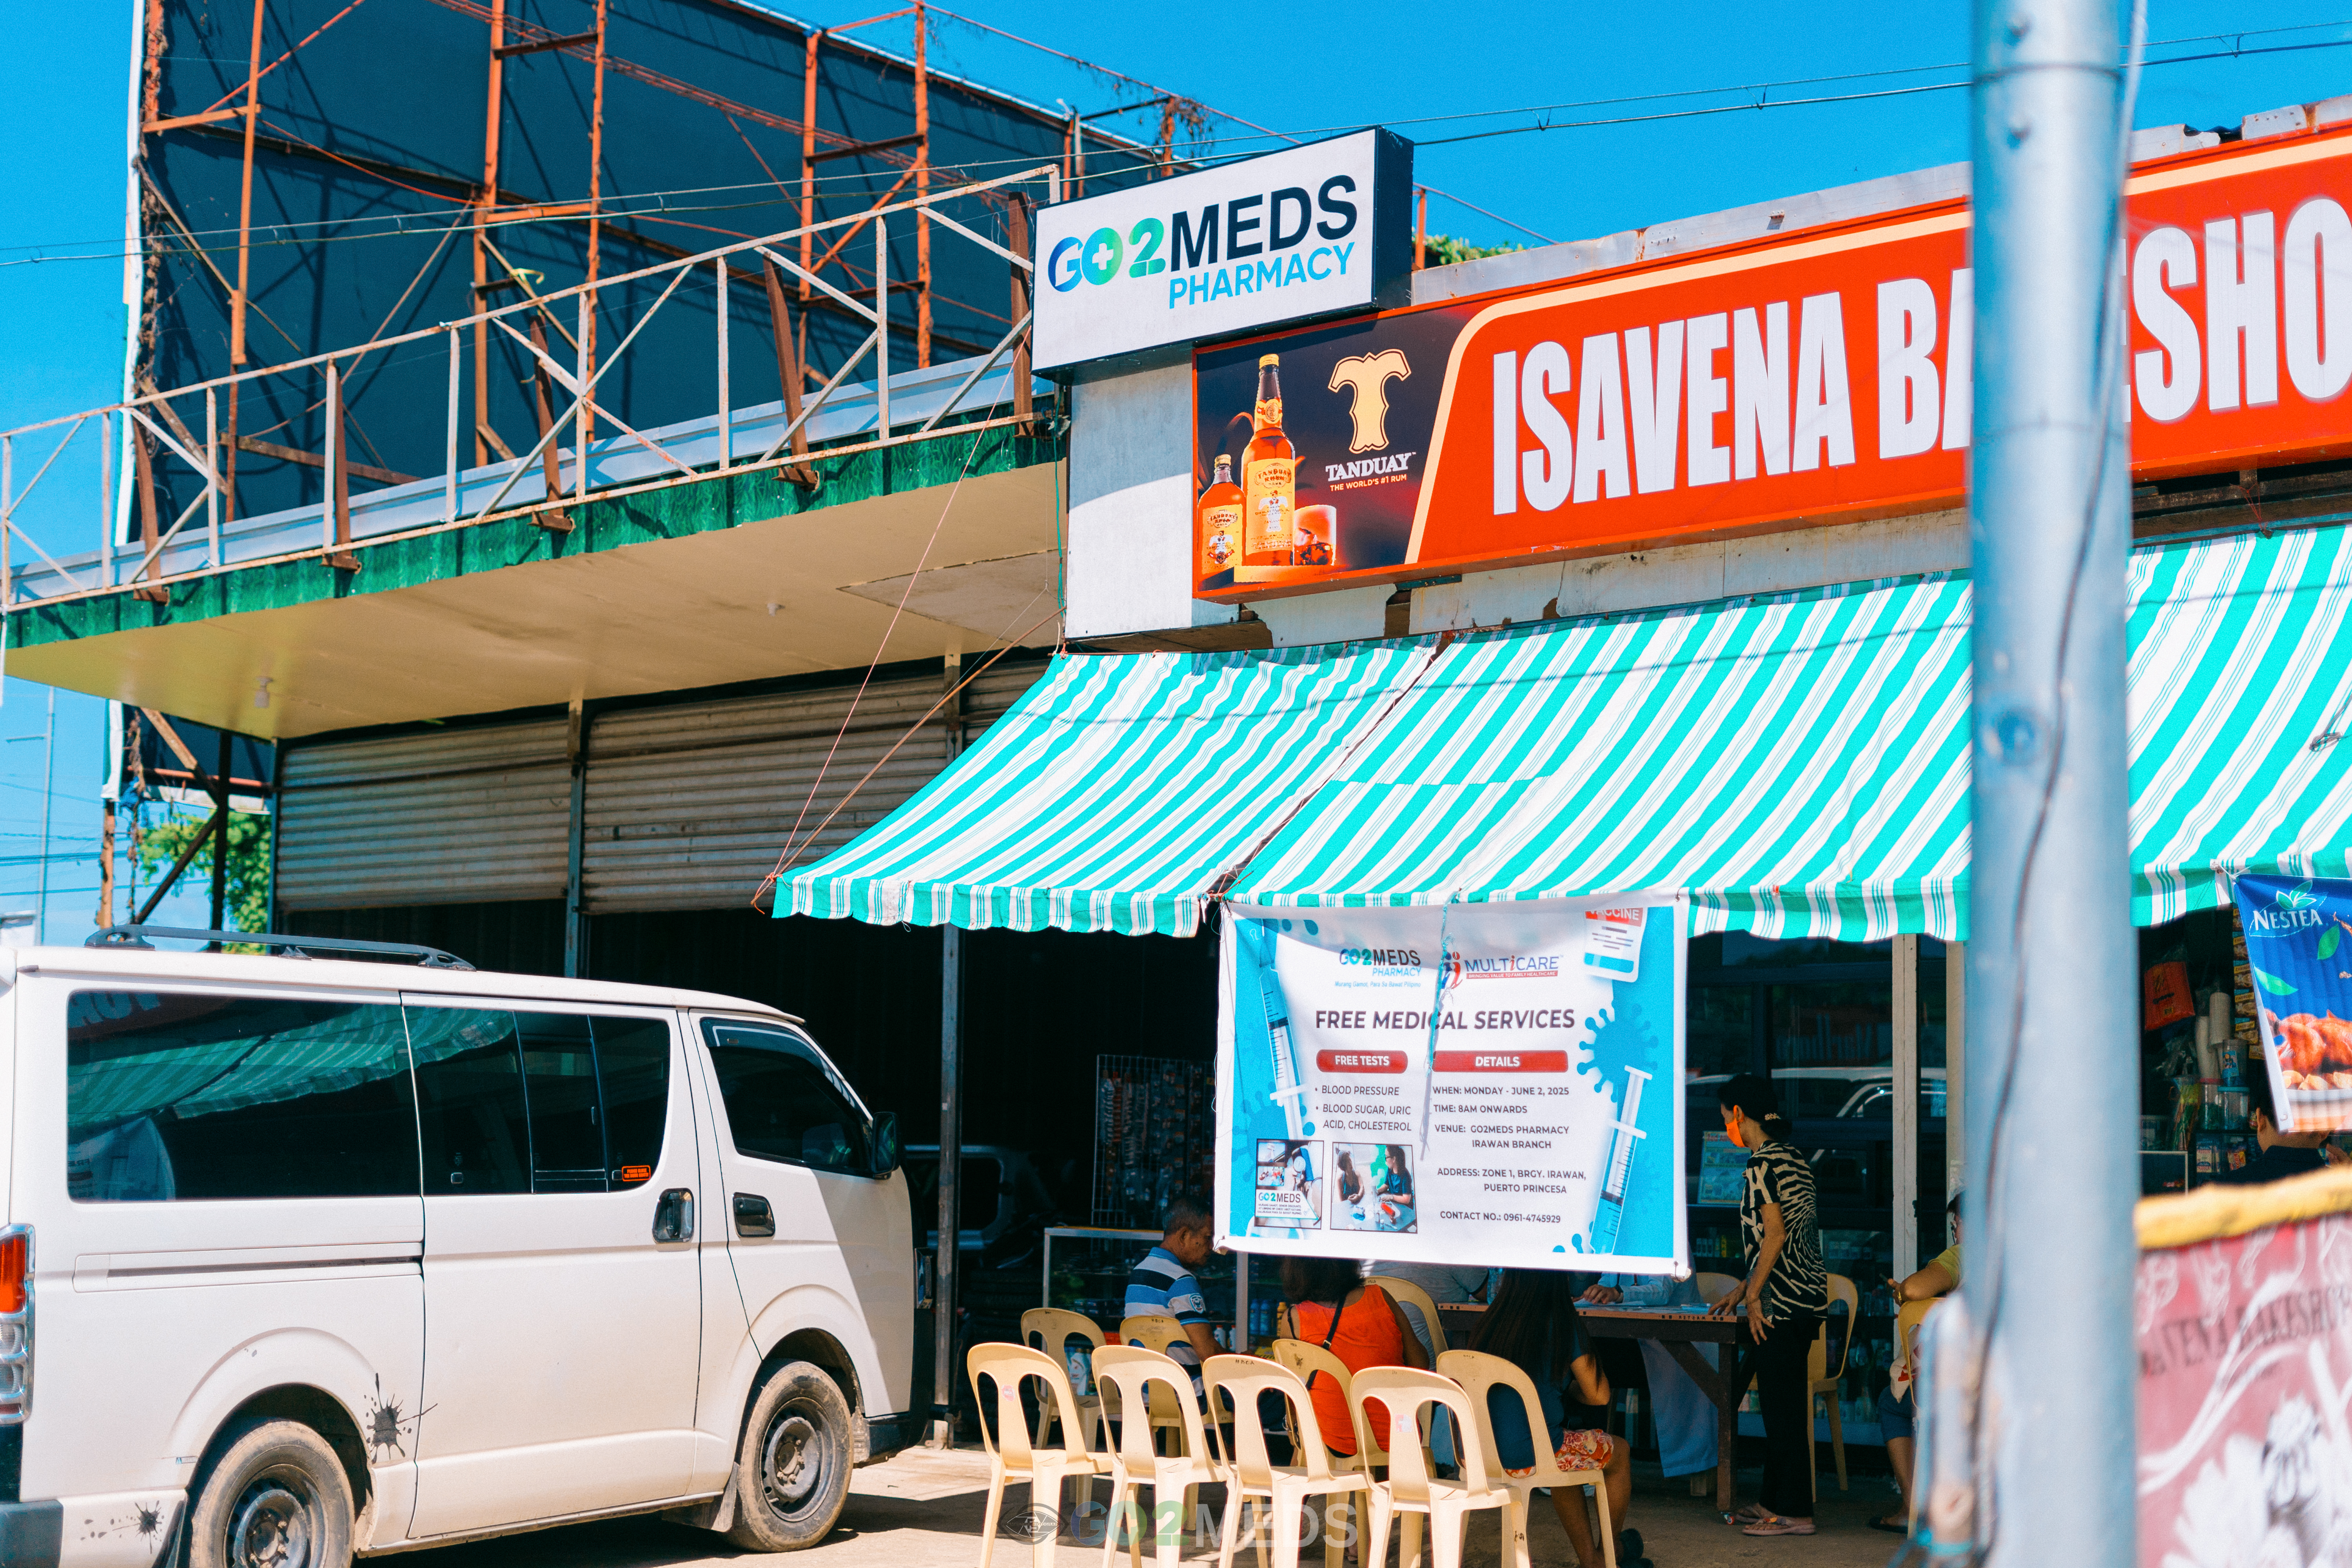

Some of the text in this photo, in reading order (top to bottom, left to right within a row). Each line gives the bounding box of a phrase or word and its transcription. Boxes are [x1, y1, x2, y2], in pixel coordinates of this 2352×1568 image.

[1048, 174, 1357, 292] GO2MEDS
[1169, 241, 1356, 309] PHARMACY
[1493, 198, 2352, 516] ISAVENA BSHO
[1325, 452, 1412, 482] TANDUAY
[1330, 474, 1407, 492] THE WORLD'S #1 RUM
[2252, 909, 2323, 931] NESTEA
[1339, 949, 1421, 966] GO2MEDS
[1372, 967, 1422, 976] PHARMACY
[1316, 1010, 1367, 1028] FREE
[1474, 1009, 1575, 1029] SERVICES
[1335, 1055, 1390, 1066] FREE TESTS
[1475, 1056, 1520, 1067] DETAILS
[1322, 1085, 1399, 1095] BLOOD PRESSURE
[1432, 1086, 1462, 1094] WHEN:
[1464, 1087, 1503, 1095] MONDAY
[1537, 1087, 1545, 1096] 2,
[1548, 1087, 1570, 1095] 2025
[1323, 1104, 1411, 1116] BLOOD SUGAR, URIC
[1458, 1105, 1477, 1113] 8AM
[1323, 1120, 1412, 1131] ACID, CHOLESTEROL
[1434, 1124, 1569, 1134] VENUE: GO2MEDS PHARMACY
[1472, 1140, 1552, 1149] IRAWAN BRANCH
[1437, 1168, 1586, 1181] ADDRESS: ZONE 1, BRGY. IRAWAN,
[1484, 1183, 1567, 1194] PUERTO PRINCESA
[1258, 1192, 1301, 1203] GO2MEDS
[1440, 1211, 1561, 1223] CONTACT NO.: 0961-4745929
